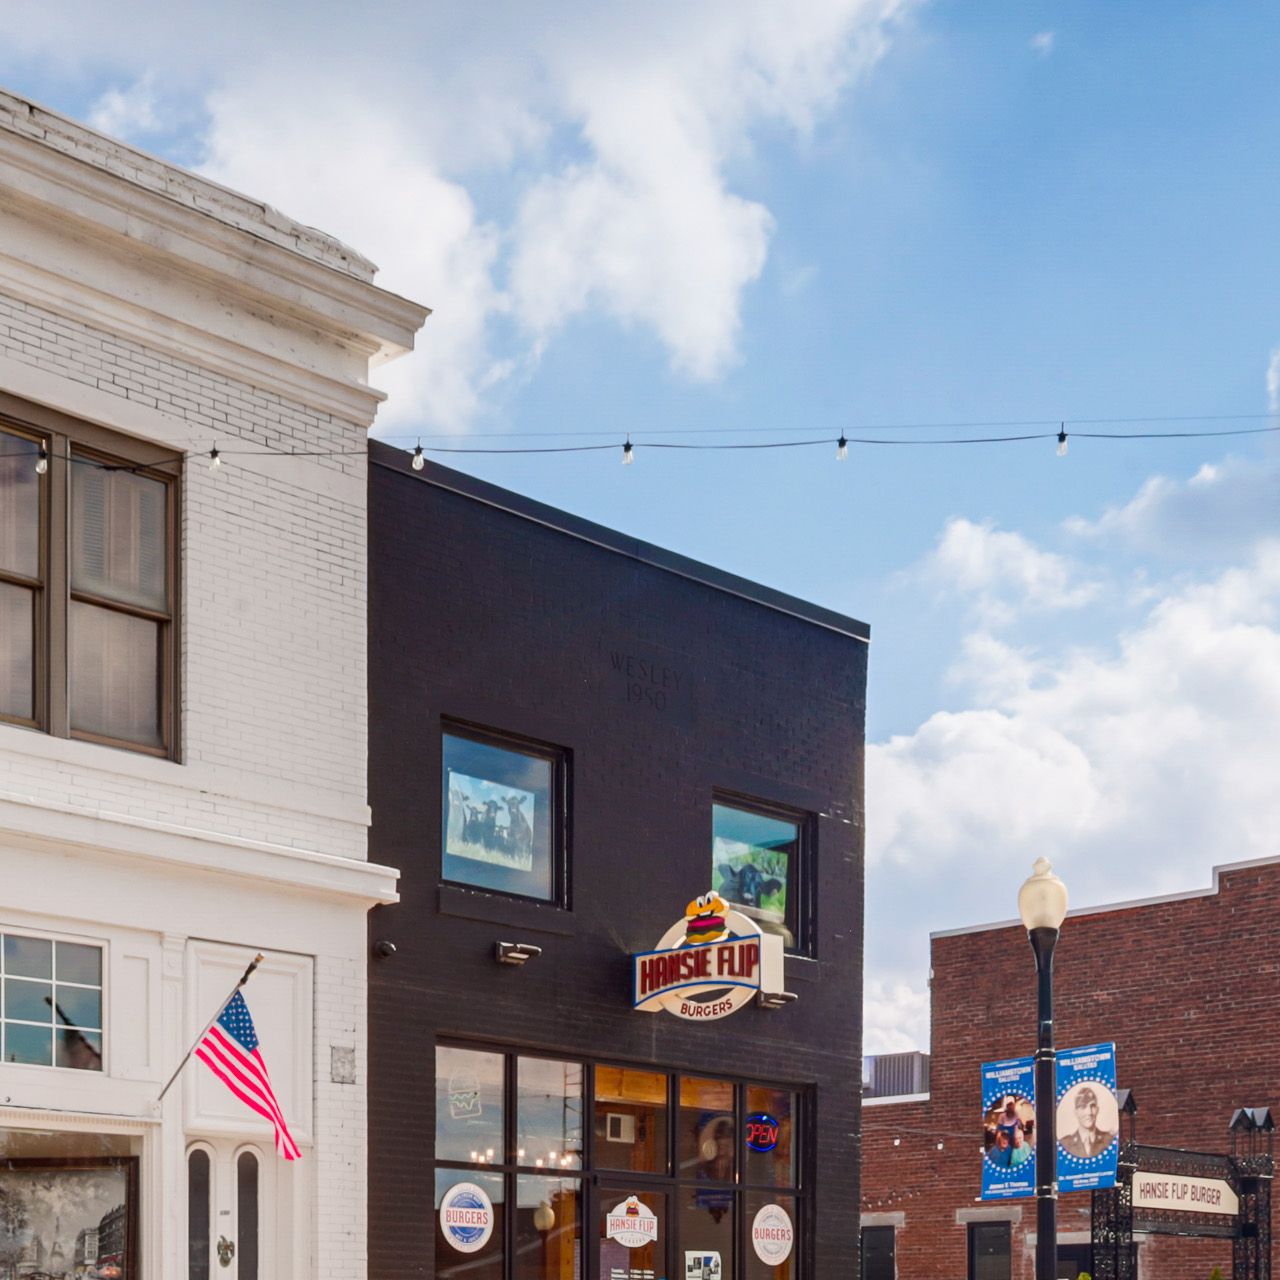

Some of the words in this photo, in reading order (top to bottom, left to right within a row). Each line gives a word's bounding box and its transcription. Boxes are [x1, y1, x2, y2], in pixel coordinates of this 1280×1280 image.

[640, 948, 712, 995] HANSIE
[717, 943, 759, 978] FLIP
[680, 998, 733, 1017] BURGERS
[1140, 1182, 1169, 1200] HANSIE
[1171, 1183, 1188, 1200] FLIP
[1191, 1185, 1222, 1206] BURGER
[445, 1209, 489, 1225] BURGERS
[610, 1218, 637, 1233] HANSIE
[639, 1219, 655, 1234] FLIP
[754, 1227, 792, 1241] BURGERS
